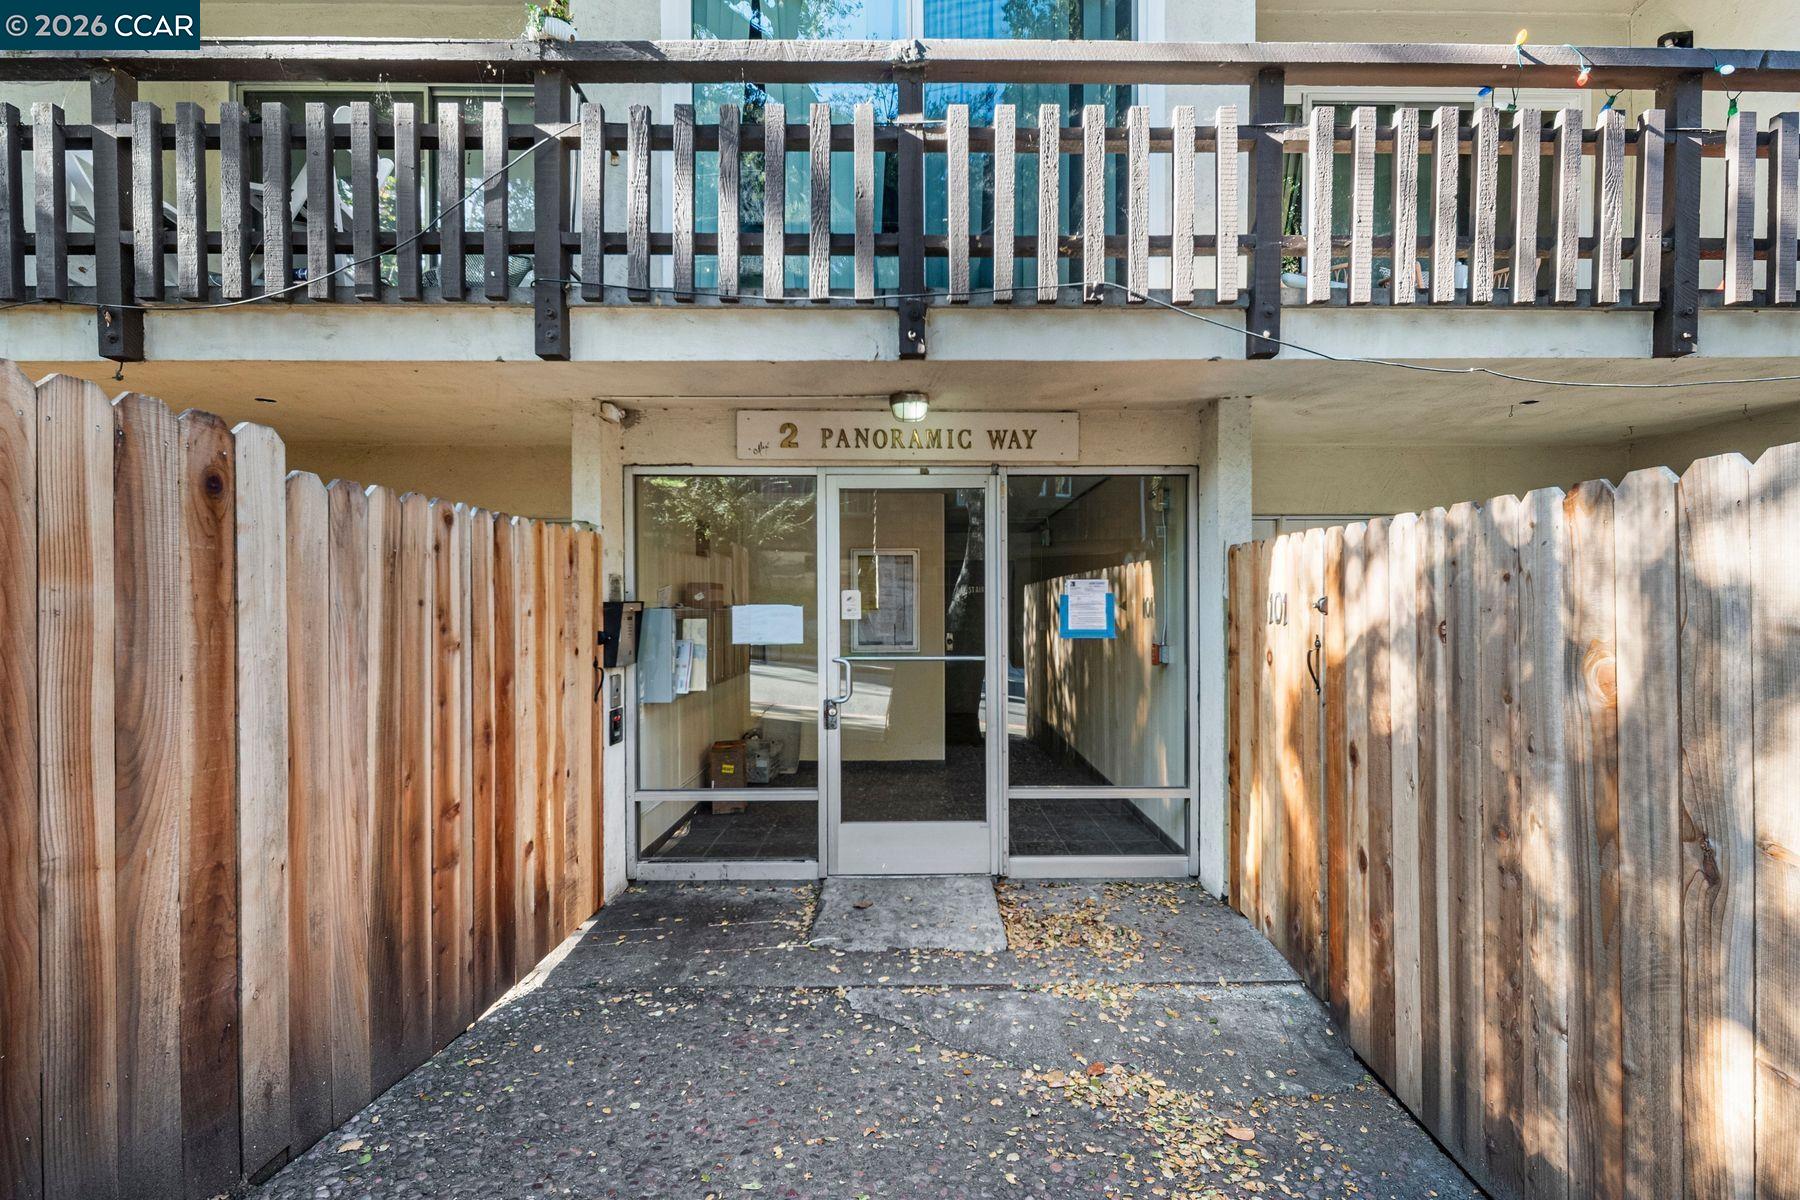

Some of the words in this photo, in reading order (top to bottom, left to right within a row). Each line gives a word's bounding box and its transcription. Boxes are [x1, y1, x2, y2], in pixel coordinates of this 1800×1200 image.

[779, 422, 799, 449] 2
[820, 427, 972, 450] PANORAMIC
[987, 429, 1038, 450] WAY
[1268, 592, 1288, 626] 101
